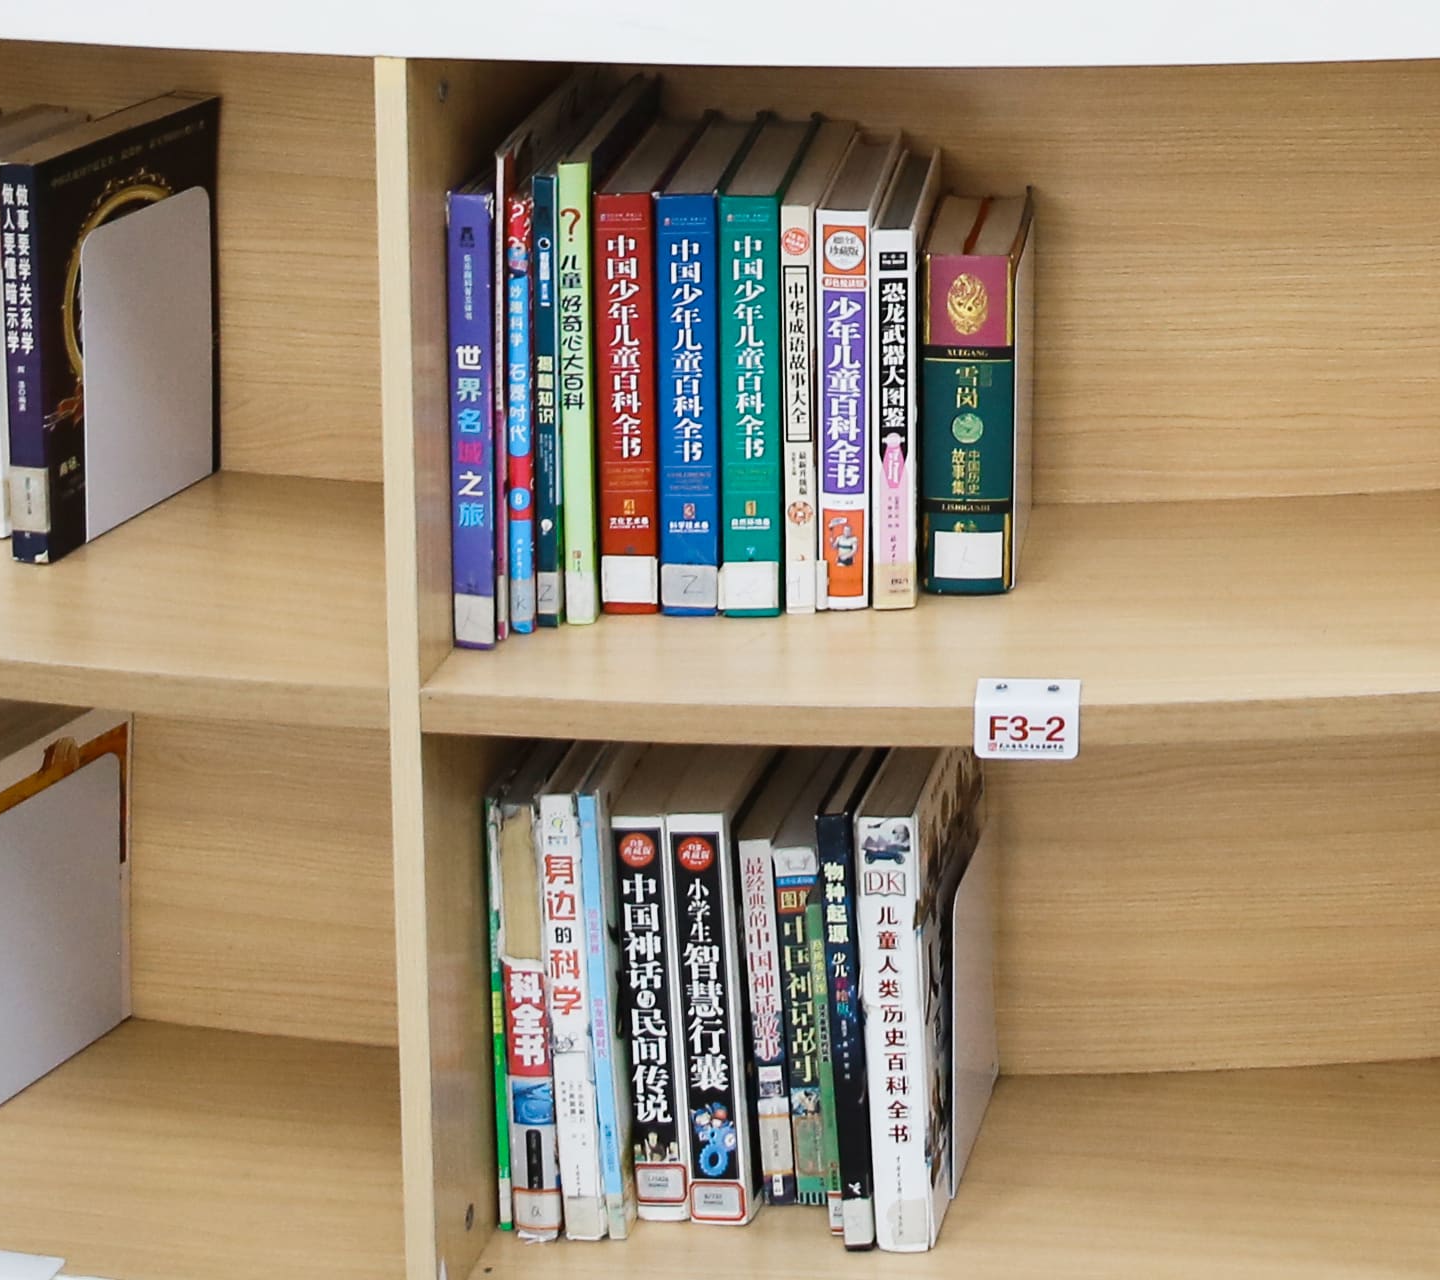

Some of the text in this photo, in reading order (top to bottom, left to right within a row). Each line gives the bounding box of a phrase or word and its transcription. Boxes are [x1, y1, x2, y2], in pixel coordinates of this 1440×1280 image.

[2, 184, 20, 354] 做人要懂暗示学
[15, 185, 34, 355] 做事要学关系学
[561, 295, 584, 411] 好奇心大百科
[606, 235, 642, 459] 中国少年儿童百科全书
[670, 239, 704, 463] 中国少年儿童百科全书
[733, 235, 766, 459] 中国少年儿童百科全书
[789, 282, 807, 424] 中华成语故事大全
[456, 345, 484, 527] 世界名城之旅
[827, 297, 861, 488] 少年儿童百科全书
[881, 282, 906, 427] 恐龙武器大图鉴
[968, 450, 980, 495] 中国历史
[990, 715, 1065, 741] F3-2
[544, 854, 582, 1015] 身边的科学
[745, 857, 781, 1062] 最经典的中国神话故事
[823, 862, 848, 944] 物种起源
[866, 874, 904, 893] DK
[510, 973, 546, 1067] 科全书
[623, 873, 672, 1124] 中国神话与民间传说
[683, 878, 729, 1092] 小学生智慧行囊
[875, 906, 910, 1144] 儿童人类历史百科全书
